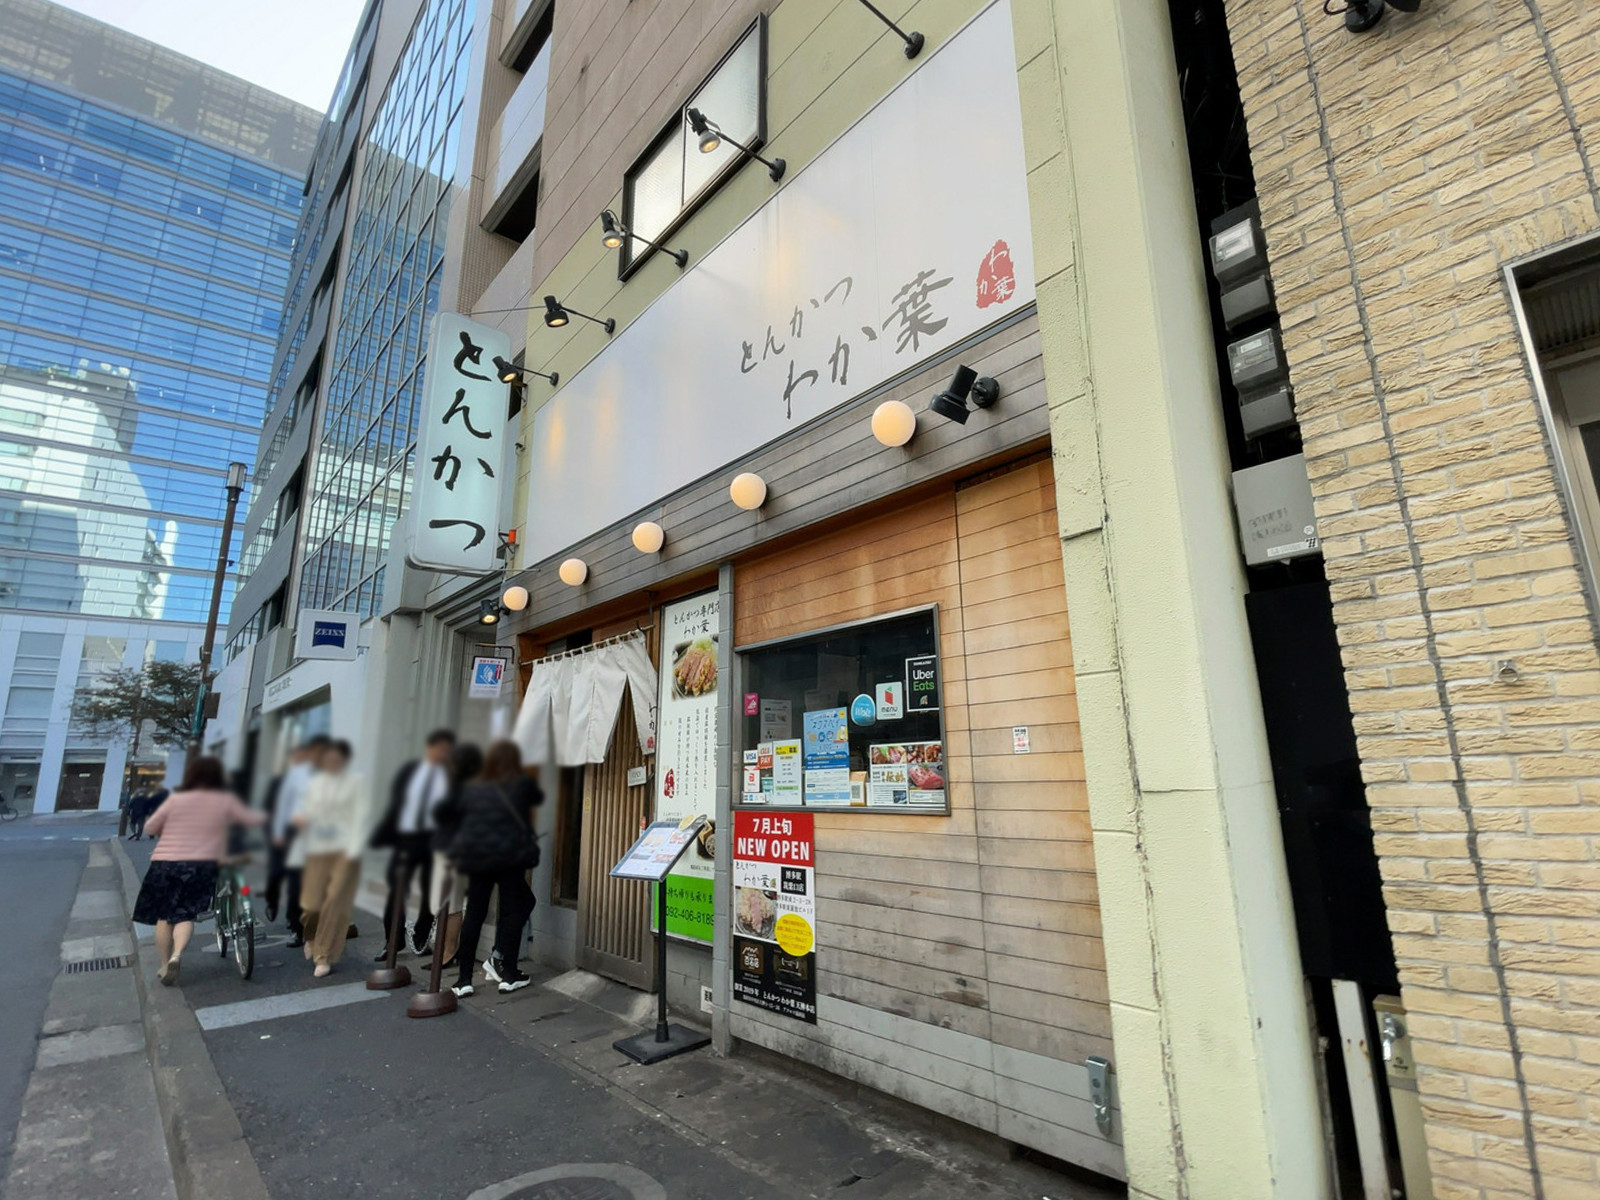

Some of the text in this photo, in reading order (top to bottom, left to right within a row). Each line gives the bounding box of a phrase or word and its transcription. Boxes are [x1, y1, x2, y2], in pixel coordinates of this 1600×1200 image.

[741, 276, 853, 374] とんかつ
[783, 268, 954, 419] わか葉
[428, 331, 496, 551] とんかつ
[315, 628, 345, 637] ZEISS
[913, 669, 935, 680] Uber
[913, 681, 935, 692] Eats
[745, 752, 757, 760] VISA
[760, 756, 772, 766] PAY
[752, 817, 793, 836] 7月上旬
[737, 837, 810, 861] NEW OPEN
